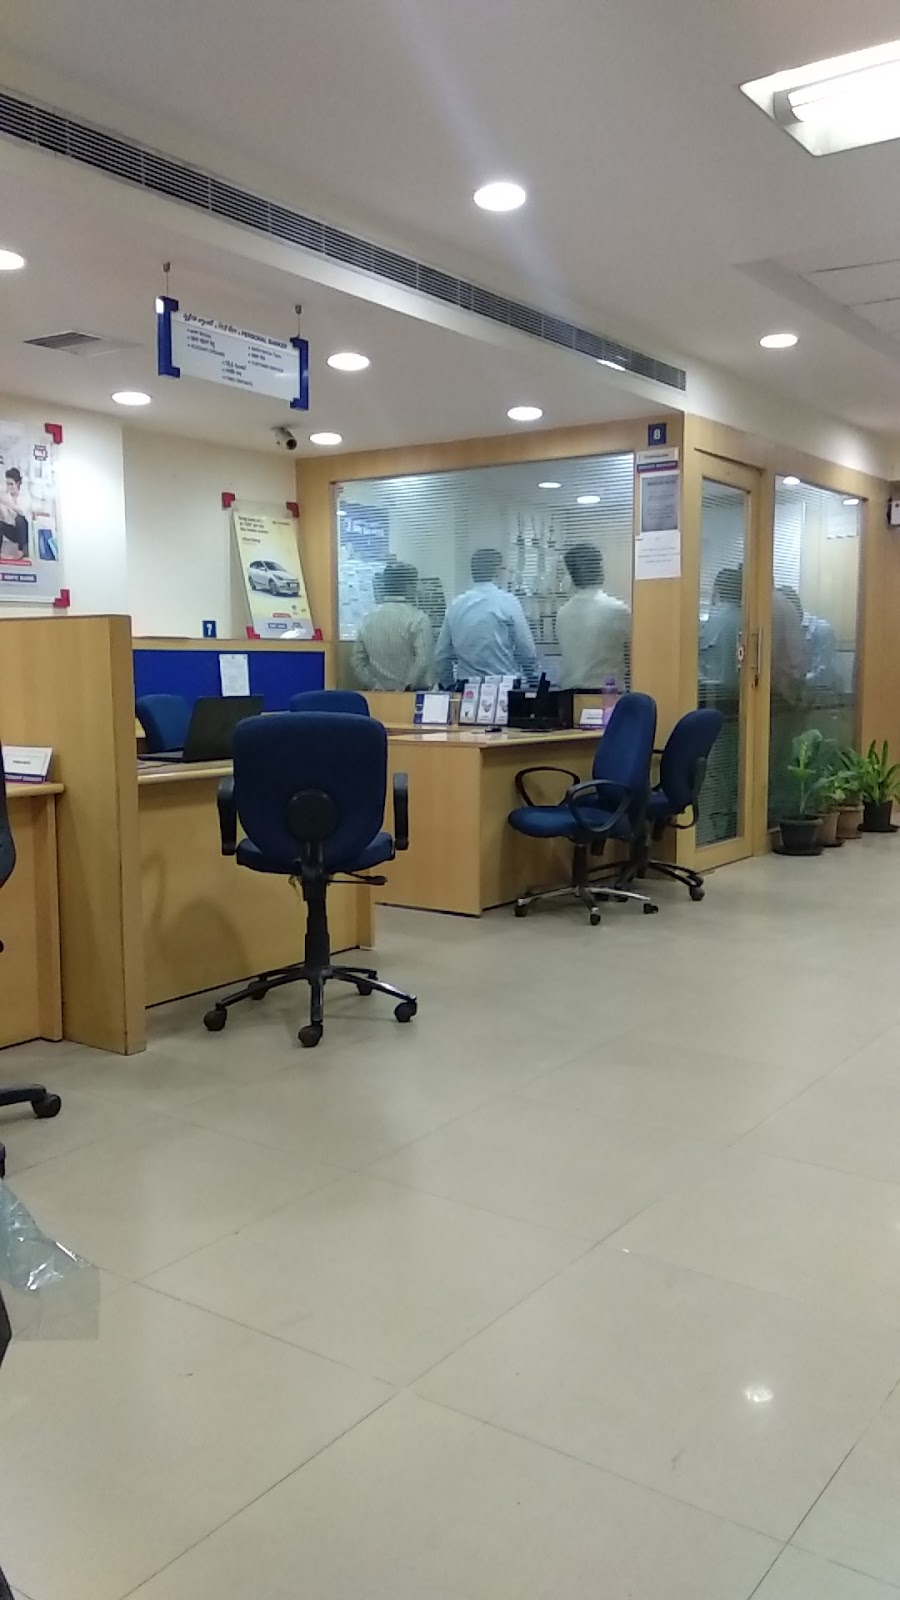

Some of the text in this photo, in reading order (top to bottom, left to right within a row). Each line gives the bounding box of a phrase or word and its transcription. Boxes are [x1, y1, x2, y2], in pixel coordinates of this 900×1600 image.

[241, 331, 288, 349] PERSONAL BANKER
[206, 623, 213, 636] 7
